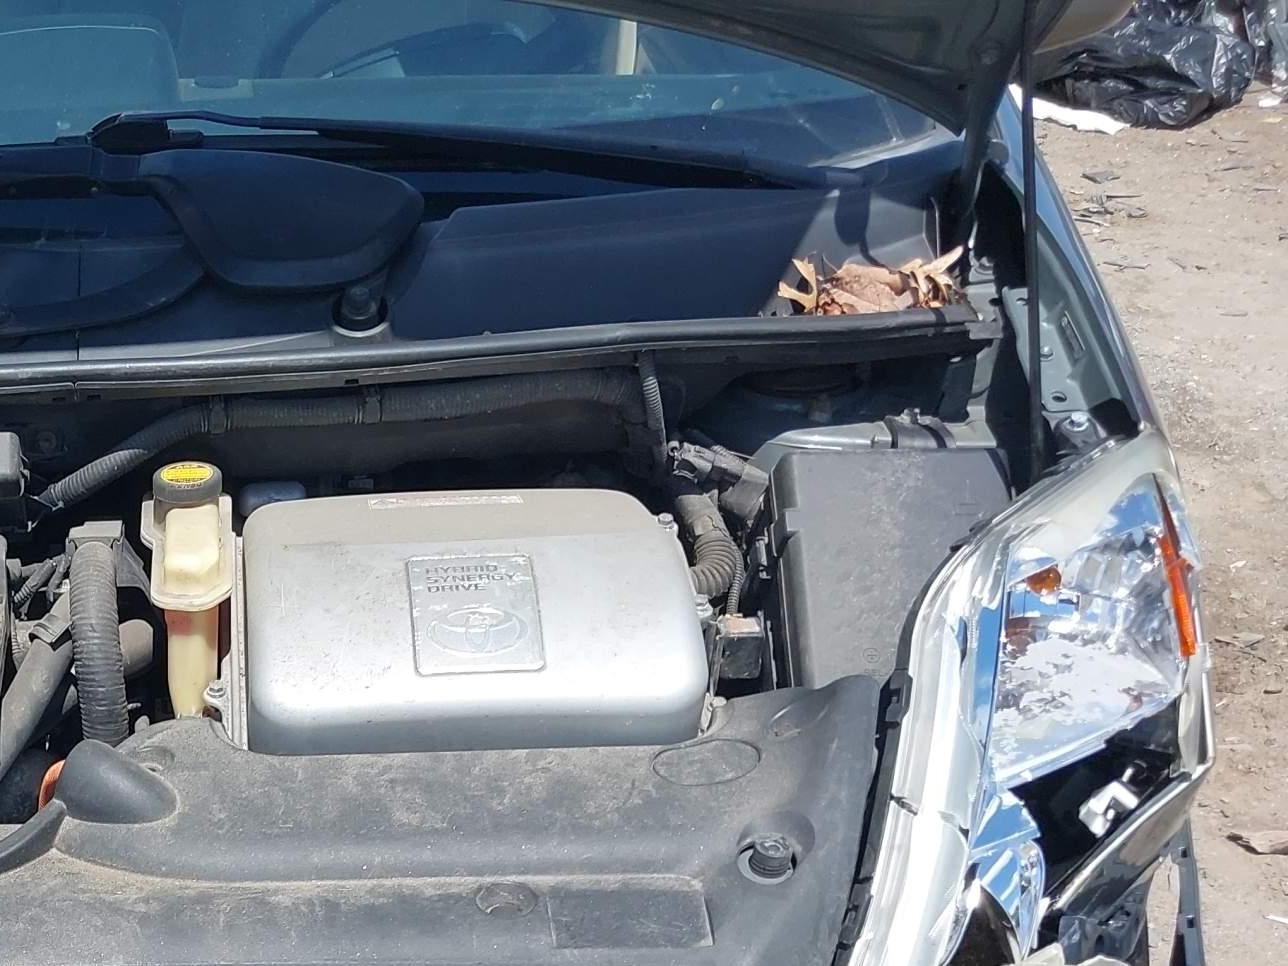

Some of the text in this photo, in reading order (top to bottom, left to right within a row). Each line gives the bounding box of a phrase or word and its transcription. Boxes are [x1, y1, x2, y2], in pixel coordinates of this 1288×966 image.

[426, 565, 498, 574] HYBRID
[426, 573, 516, 583] SYNERGY
[427, 583, 487, 593] DRIVE
